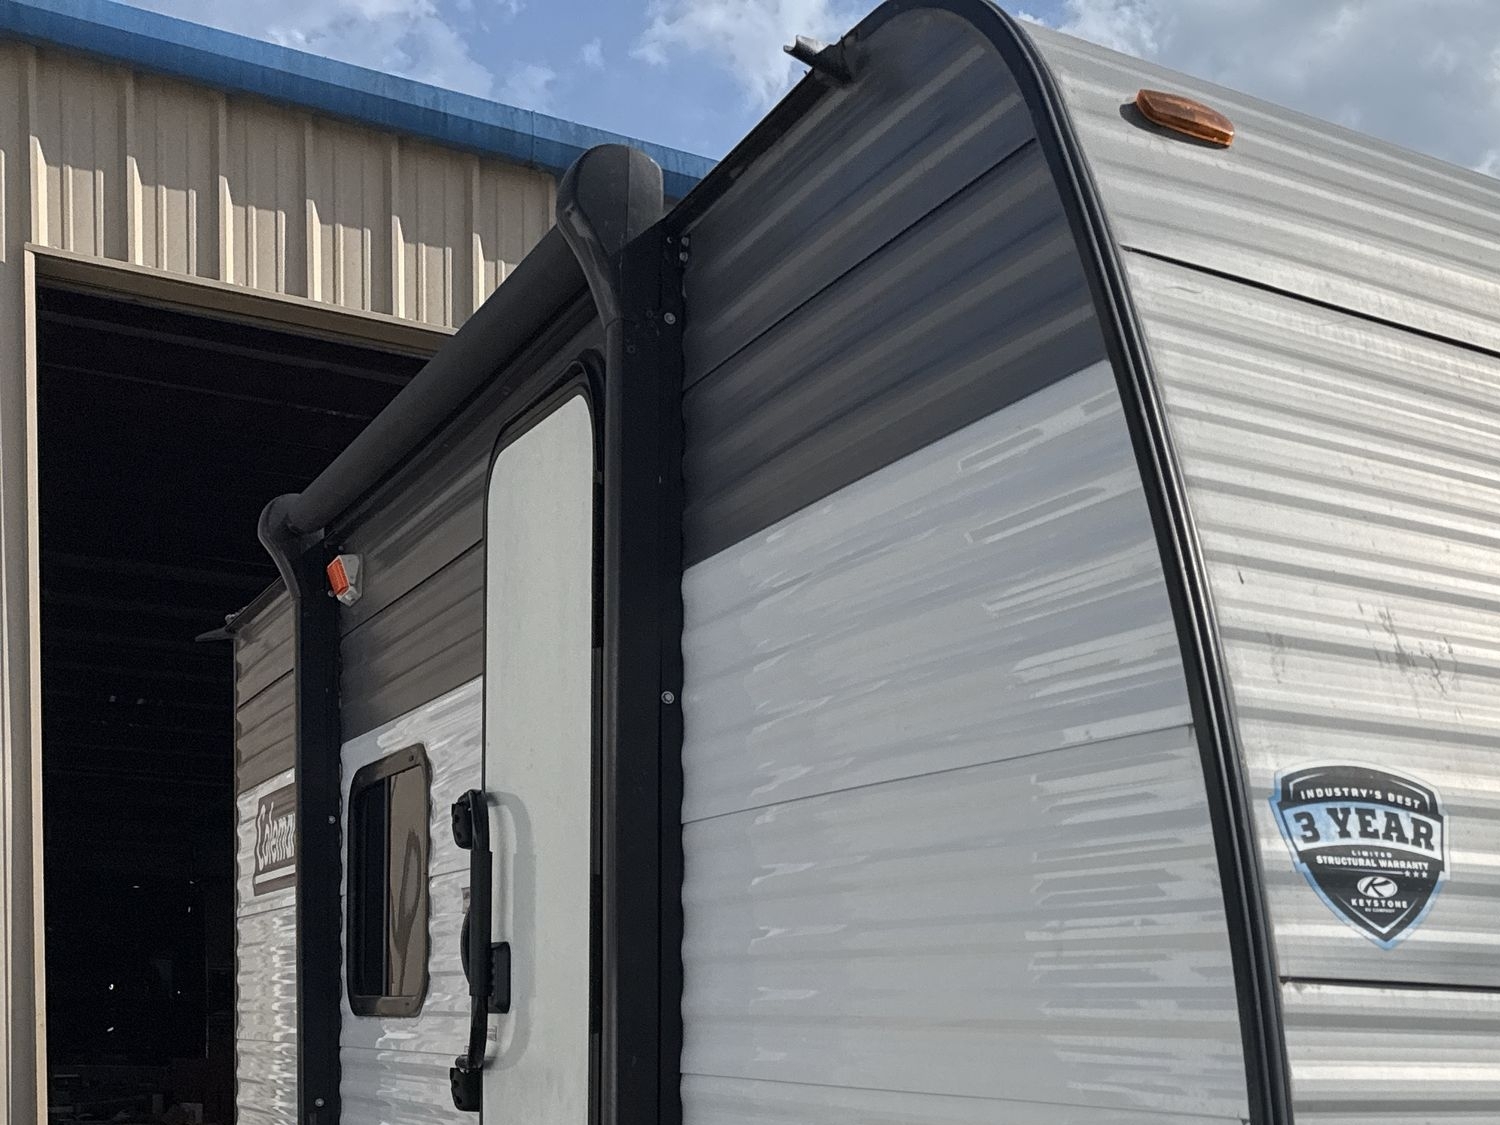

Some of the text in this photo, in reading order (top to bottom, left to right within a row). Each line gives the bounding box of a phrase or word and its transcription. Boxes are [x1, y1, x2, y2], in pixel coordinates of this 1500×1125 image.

[1300, 787, 1421, 809] INDUSTRY'S BEST
[1293, 807, 1434, 851] 3 YEAR
[1351, 850, 1392, 858] LIMITED
[1316, 855, 1429, 870] STRUCTURAL WARRANTY
[1351, 898, 1408, 909] KEYSTONE
